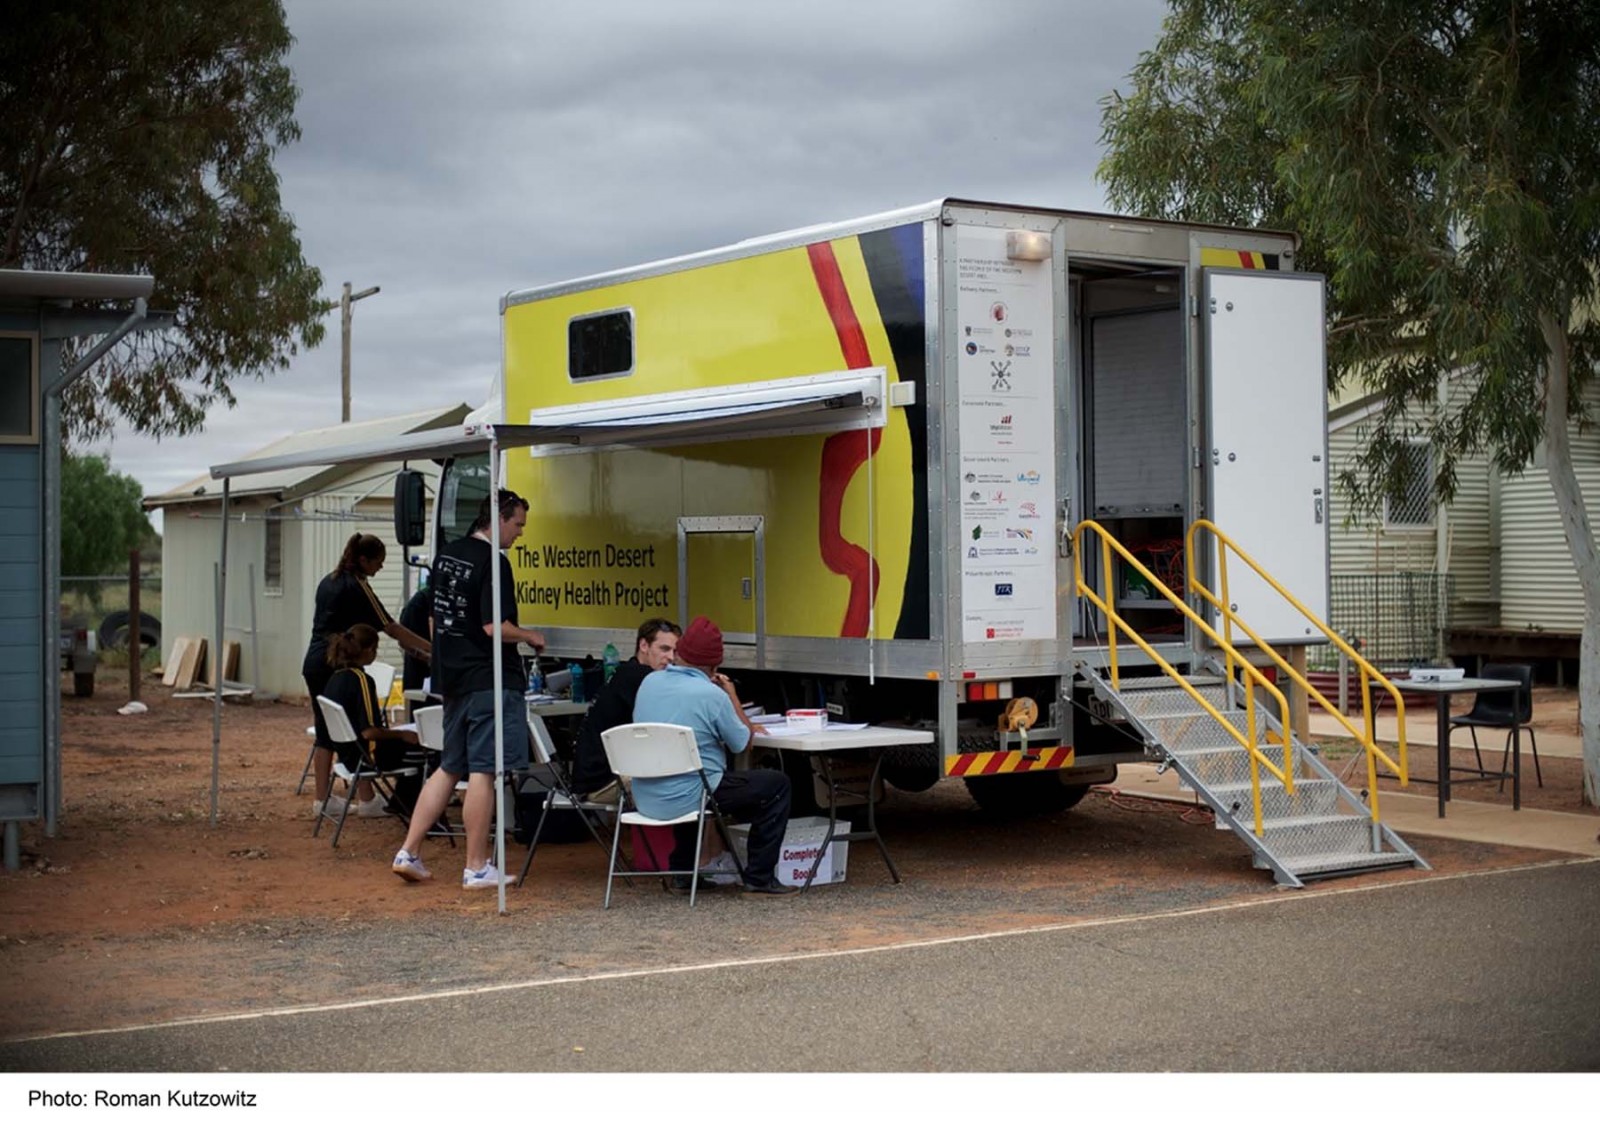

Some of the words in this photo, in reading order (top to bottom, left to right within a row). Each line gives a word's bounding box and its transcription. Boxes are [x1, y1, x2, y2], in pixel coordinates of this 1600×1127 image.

[515, 544, 540, 568] The
[543, 544, 601, 568] Western
[605, 544, 655, 568] Desert
[516, 580, 561, 611] Kidney
[564, 580, 611, 605] Health
[615, 581, 669, 613] Project
